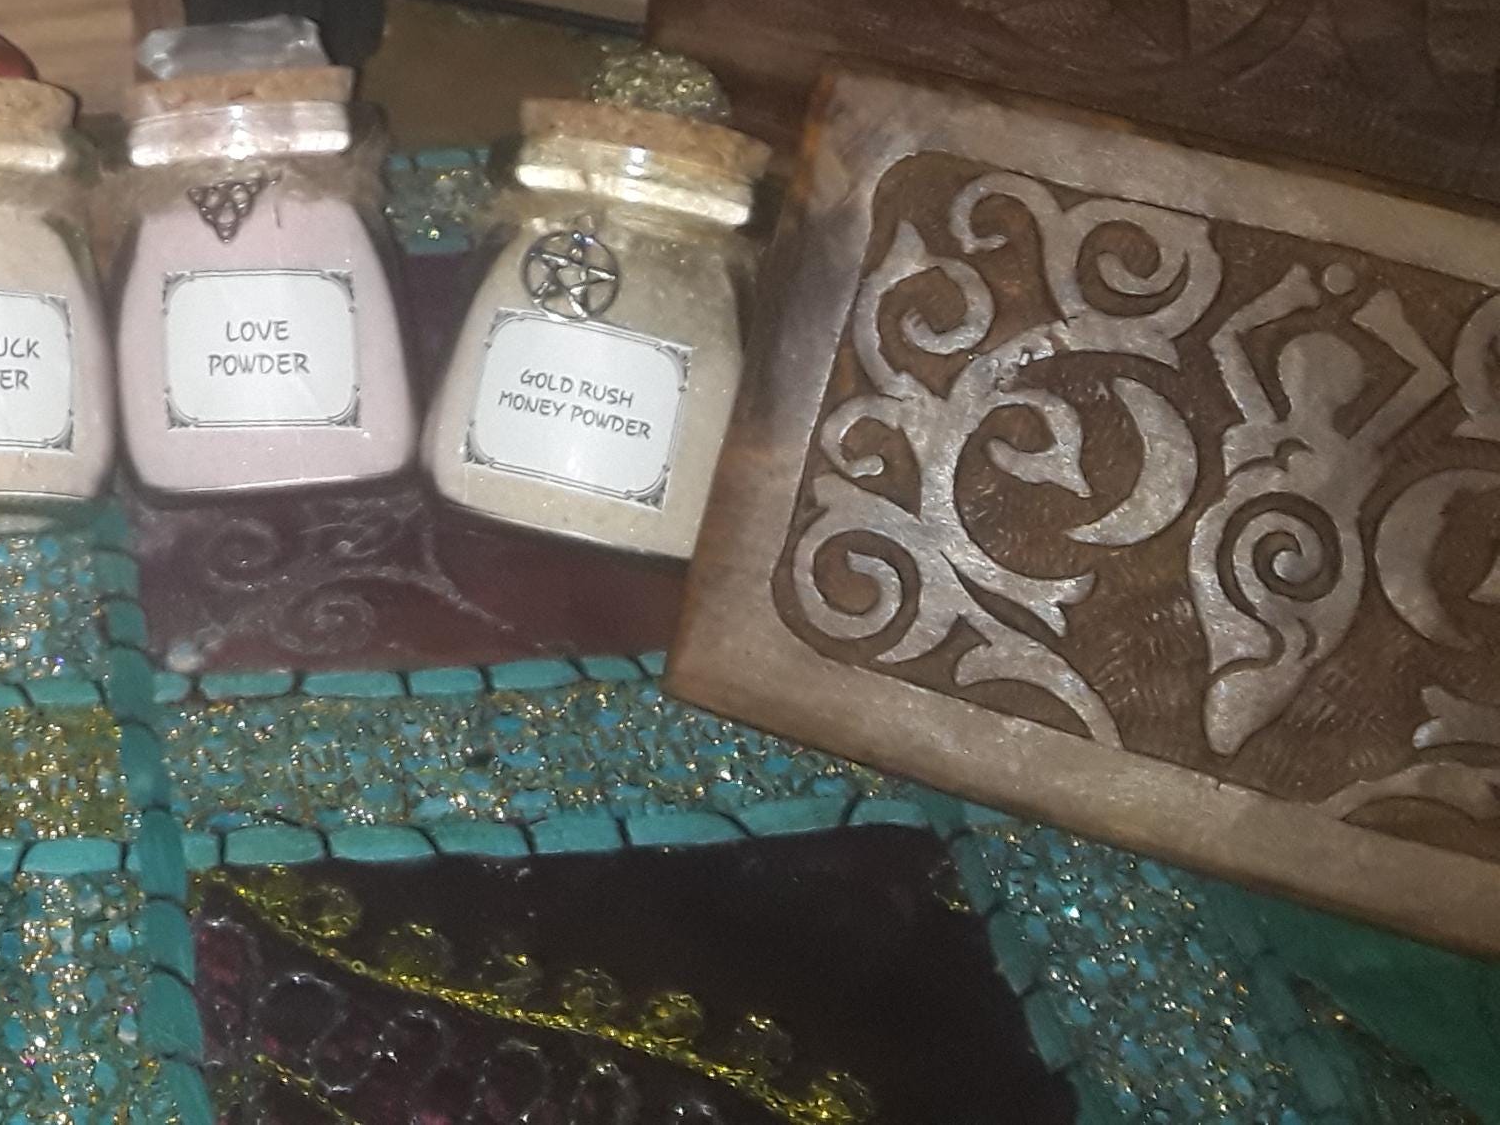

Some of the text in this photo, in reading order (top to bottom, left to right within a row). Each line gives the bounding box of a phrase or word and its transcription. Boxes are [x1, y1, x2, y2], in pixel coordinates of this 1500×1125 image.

[226, 320, 290, 342] LOVE
[208, 352, 311, 376] POWDER
[520, 369, 634, 409] GOLD RUSH
[498, 390, 652, 441] MONEY POWDER
